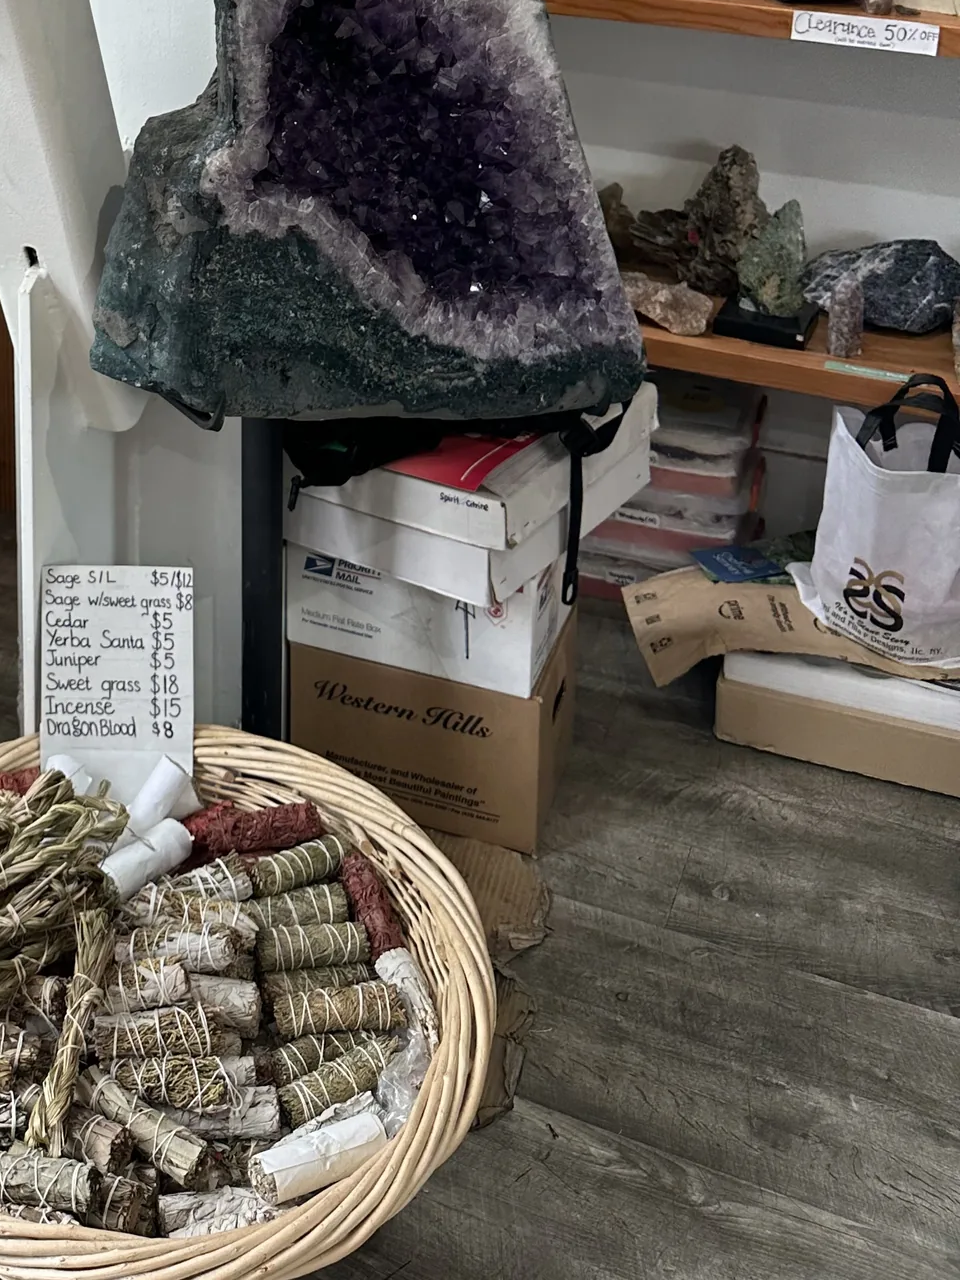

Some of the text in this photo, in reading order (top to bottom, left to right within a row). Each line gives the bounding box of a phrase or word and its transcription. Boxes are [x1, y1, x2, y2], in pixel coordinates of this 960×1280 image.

[885, 24, 918, 42] 50%
[920, 32, 938, 41] OFF
[46, 568, 81, 588] Sage
[335, 571, 361, 585] MAIL
[45, 589, 193, 616] Sage w/sweet grass $8
[46, 611, 173, 631] Cedar $5
[46, 629, 175, 652] Yerba Santa $5
[46, 649, 175, 673] Juniper $5
[46, 672, 179, 699] Sweet grass $18
[45, 695, 182, 718] Incense $15
[314, 680, 493, 738] Western Hills
[152, 721, 174, 739] $8
[364, 771, 387, 783] Most
[391, 768, 408, 778] and
[410, 772, 464, 791] Wholesaler
[467, 787, 478, 795] of
